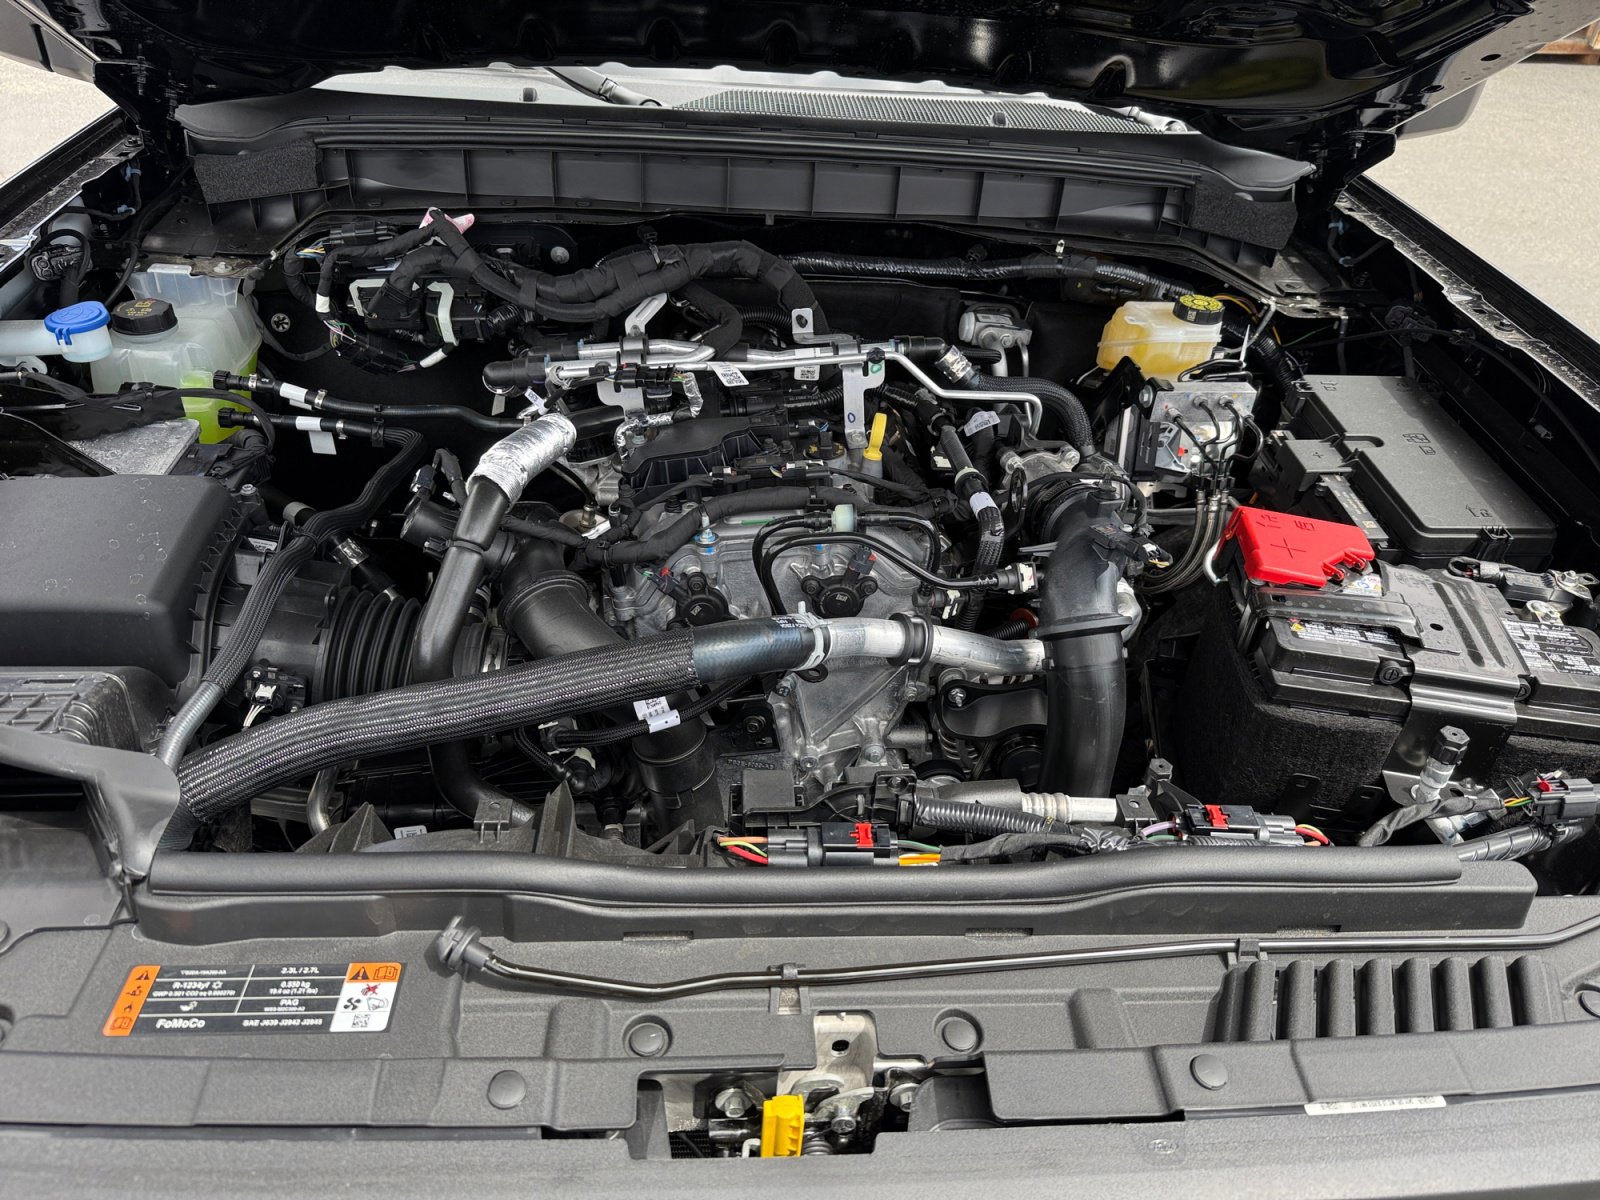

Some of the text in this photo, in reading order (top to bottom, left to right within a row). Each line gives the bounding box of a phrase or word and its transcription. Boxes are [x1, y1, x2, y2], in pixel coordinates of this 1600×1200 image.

[172, 981, 210, 990] R-1234yf
[155, 1018, 206, 1029] FoMoCo
[242, 1019, 260, 1027] SAE
